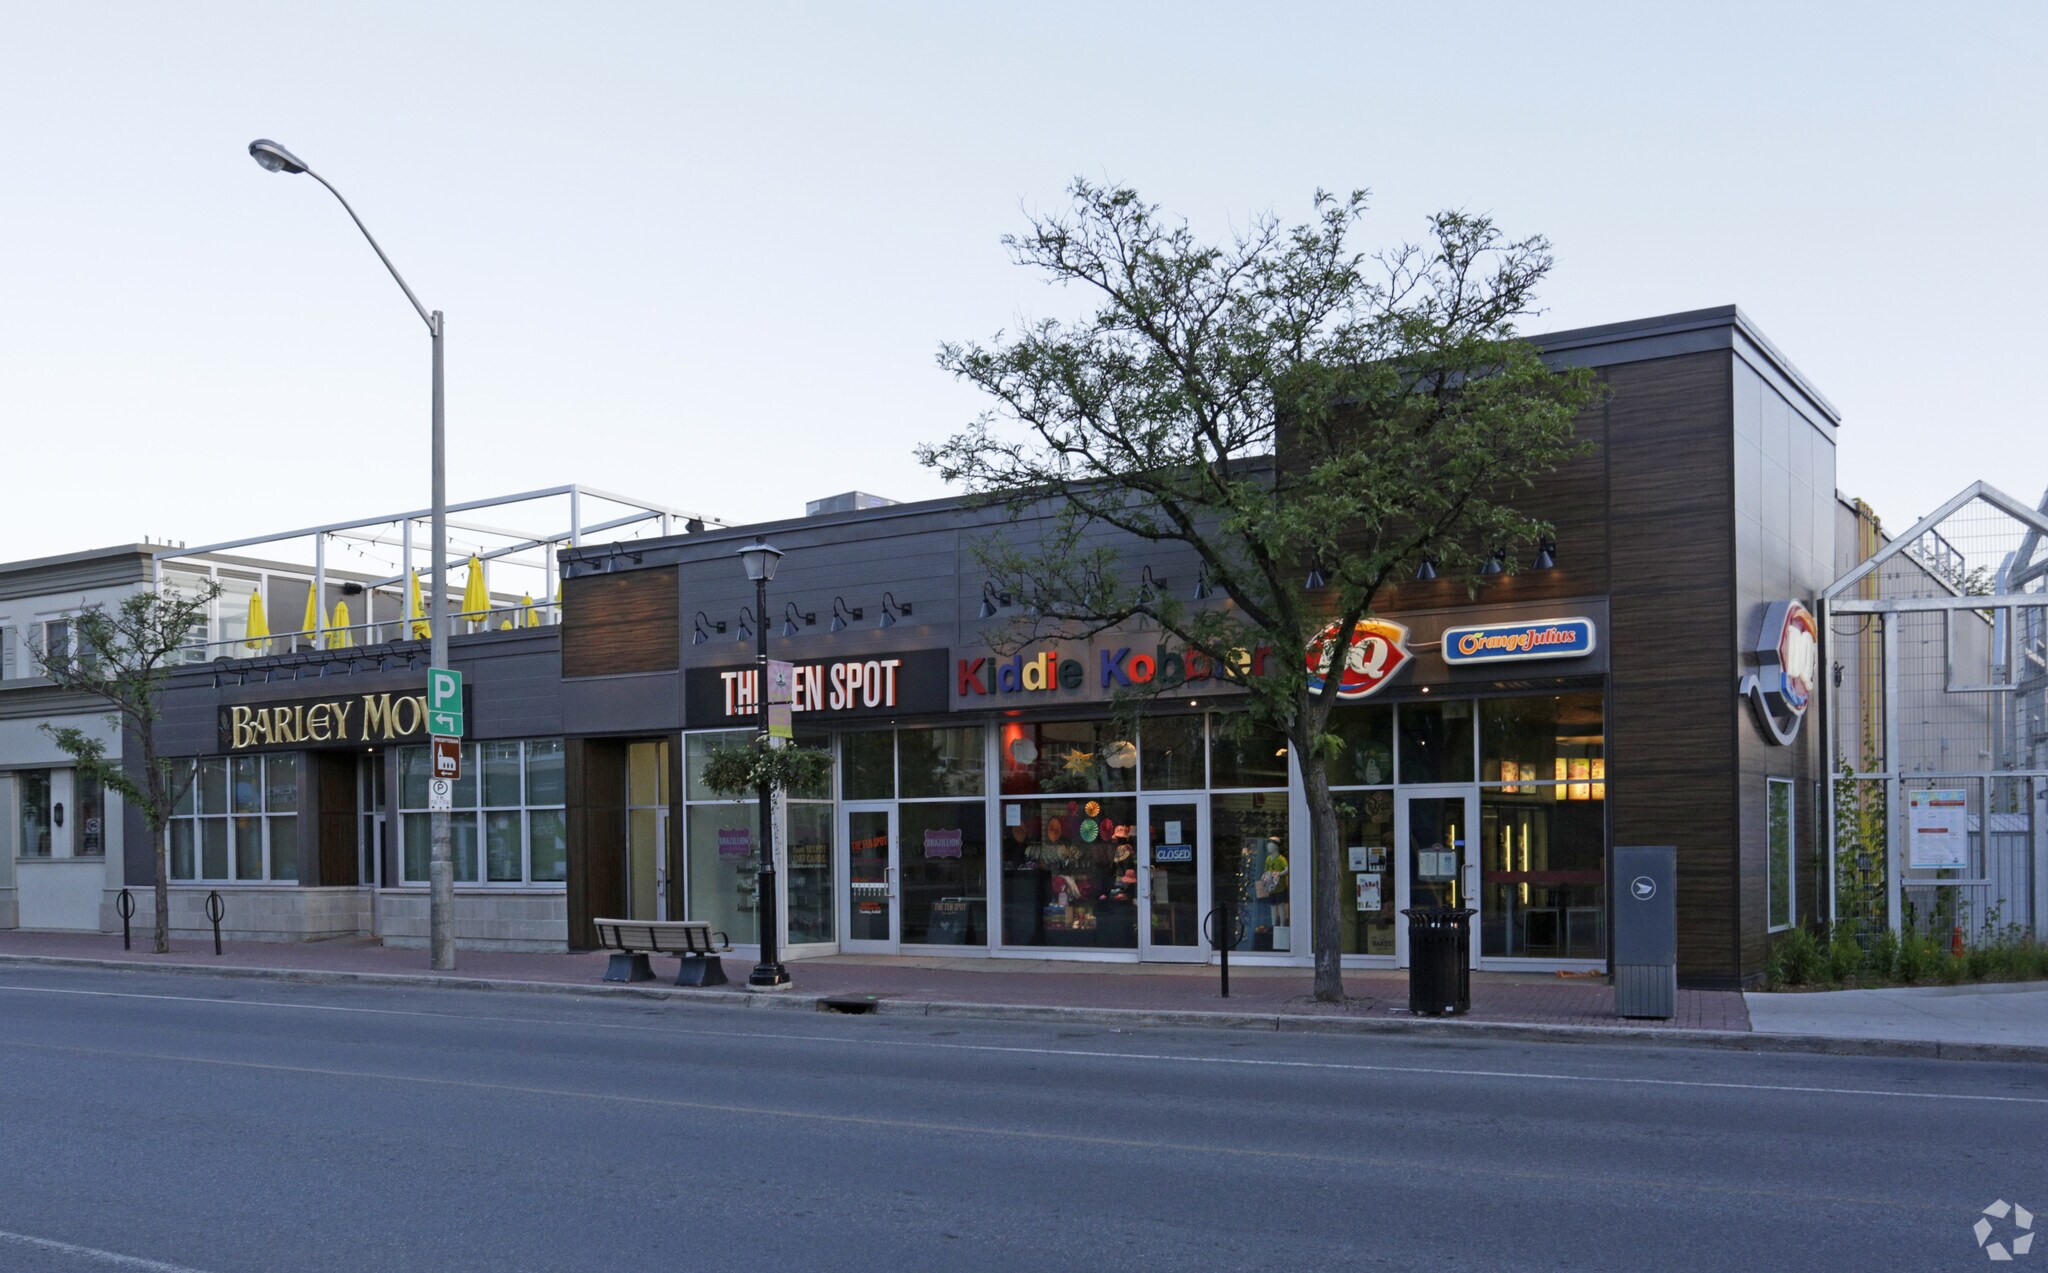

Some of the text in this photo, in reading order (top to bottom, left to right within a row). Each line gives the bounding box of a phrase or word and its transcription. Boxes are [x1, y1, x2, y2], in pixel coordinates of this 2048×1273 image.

[435, 673, 456, 708] P
[720, 659, 902, 716] TH EN SPOT
[957, 651, 1084, 696] Kiddie
[231, 701, 354, 750] BARLEY
[1157, 849, 1191, 860] CLOSED
